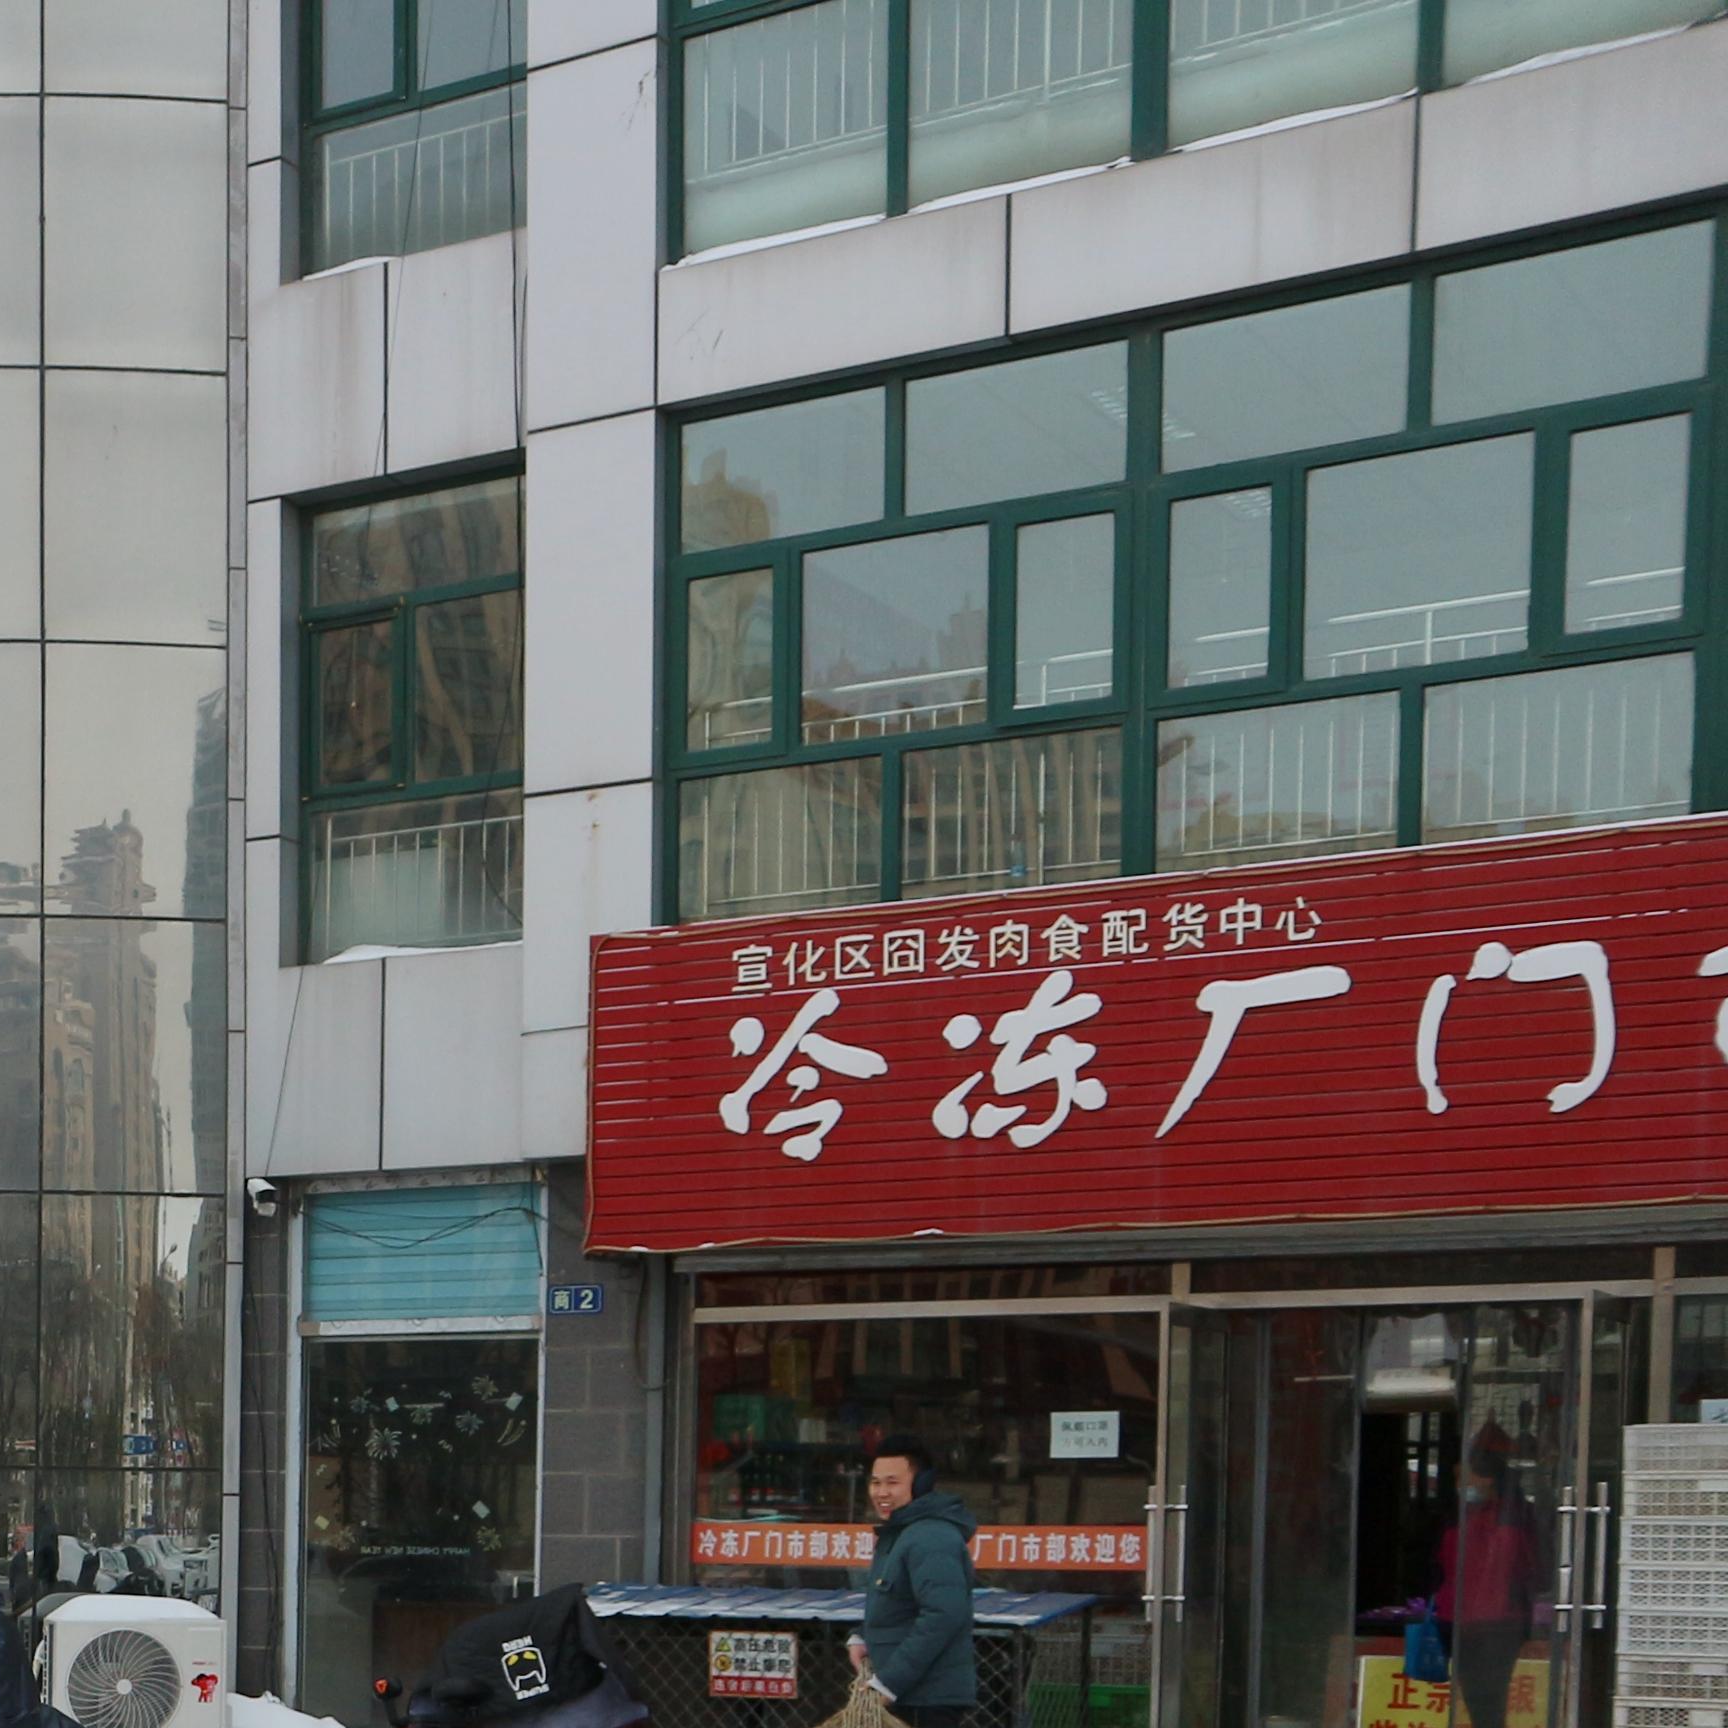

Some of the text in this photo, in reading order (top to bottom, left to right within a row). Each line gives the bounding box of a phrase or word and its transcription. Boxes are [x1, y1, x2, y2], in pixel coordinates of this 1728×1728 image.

[719, 941, 1728, 1161] 冷冻厂门
[580, 1289, 594, 1310] 2
